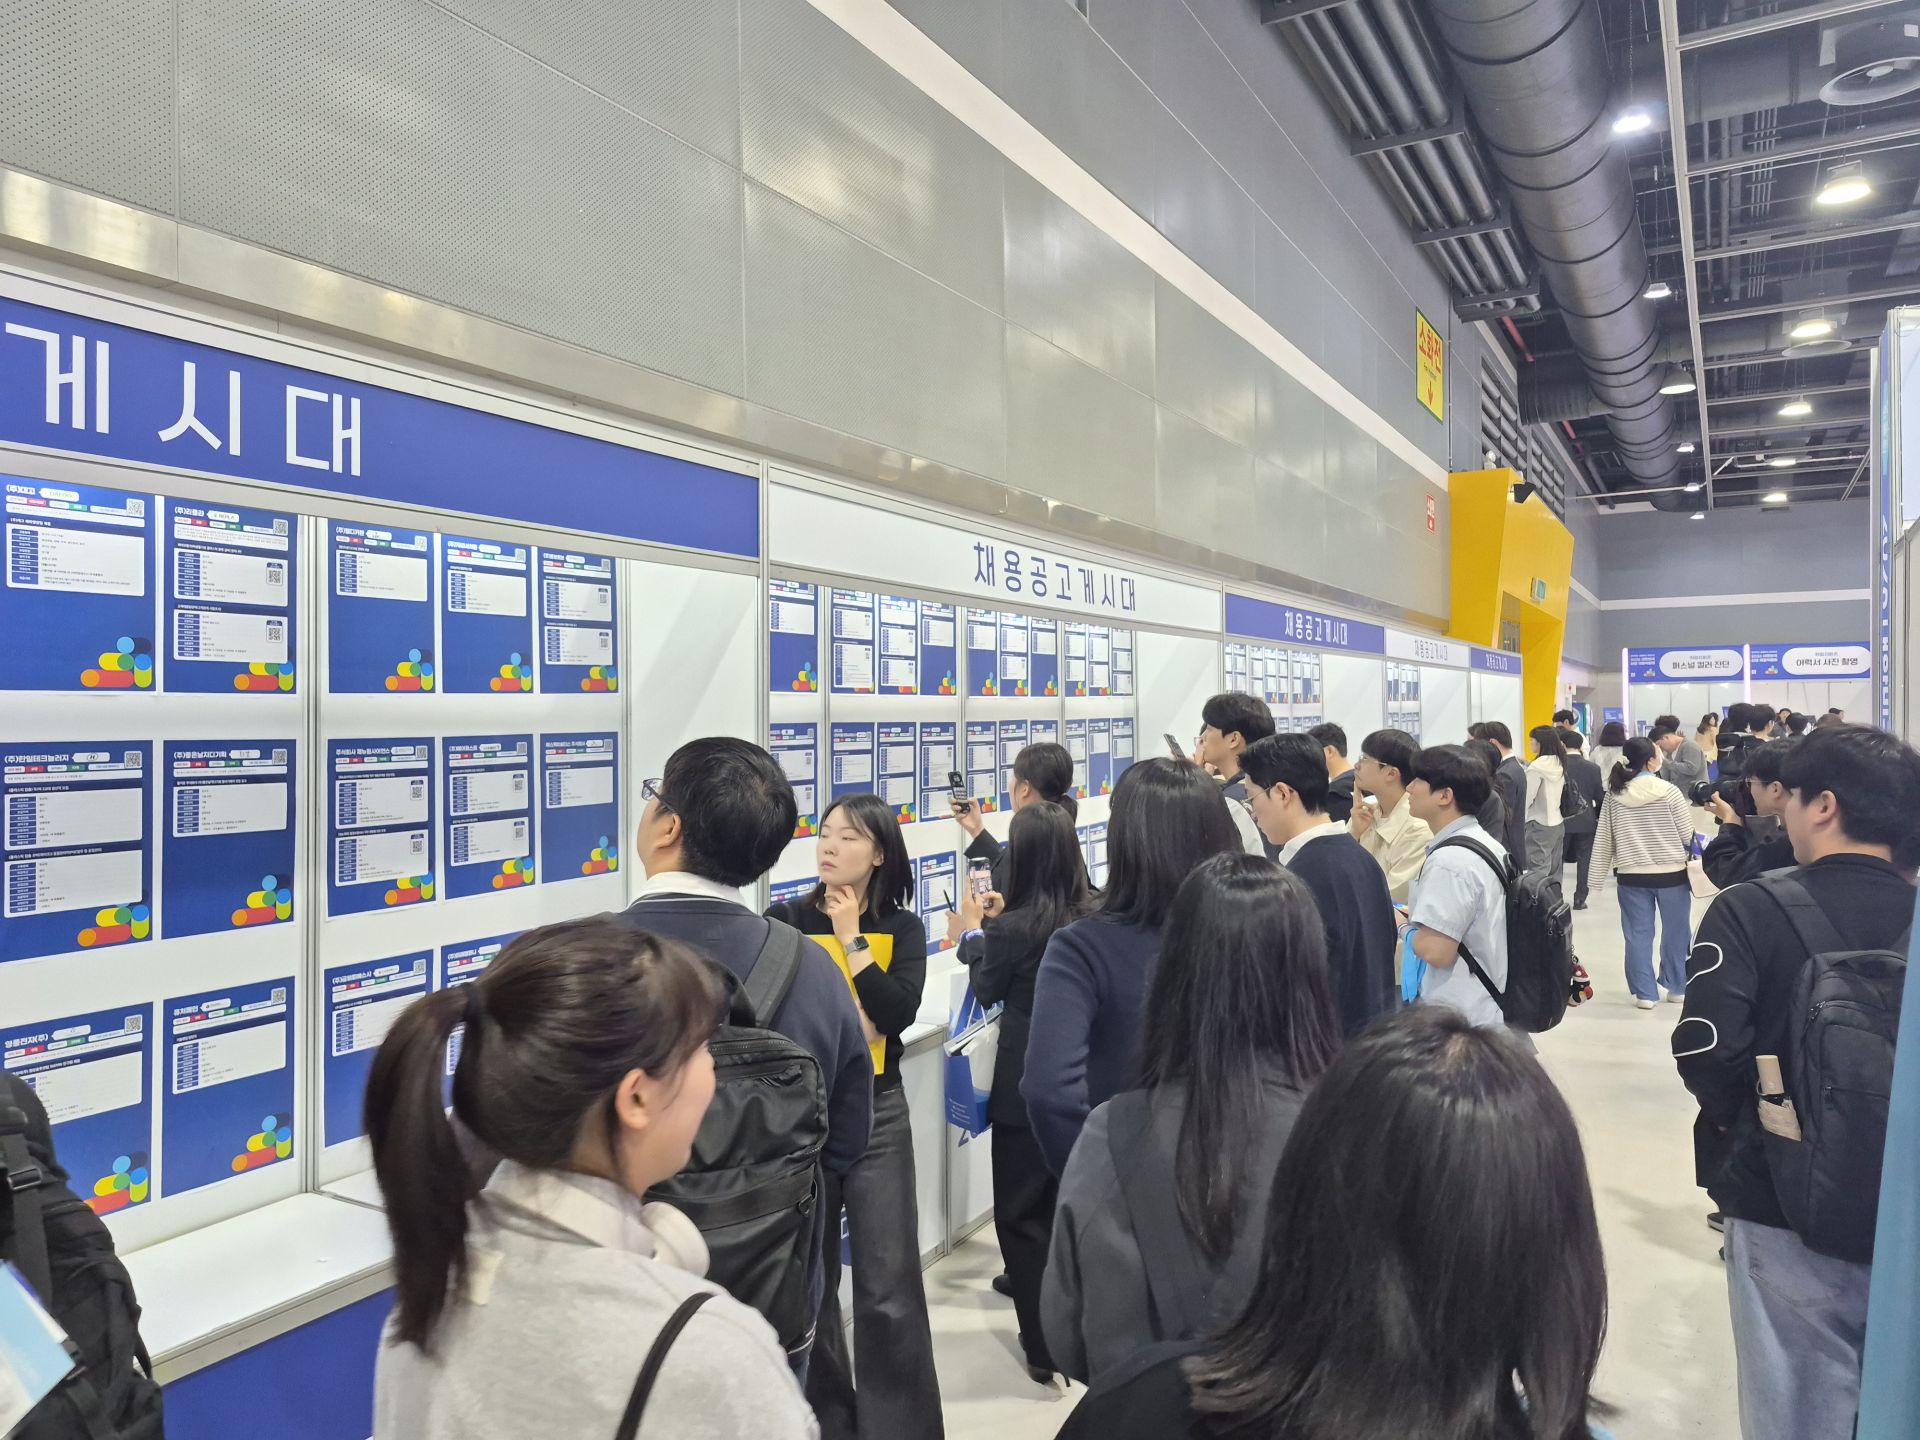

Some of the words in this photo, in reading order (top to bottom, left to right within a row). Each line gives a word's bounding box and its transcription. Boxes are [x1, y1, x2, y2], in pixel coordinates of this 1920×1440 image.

[1418, 321, 1442, 375] 소화전
[973, 541, 1136, 612] 채용공고게시대
[1284, 609, 1348, 646] 채용공고게시대
[1714, 660, 1730, 669] 진단
[1796, 658, 1821, 667] 이력서
[1822, 658, 1840, 666] 사진
[1841, 657, 1859, 666] 촬영
